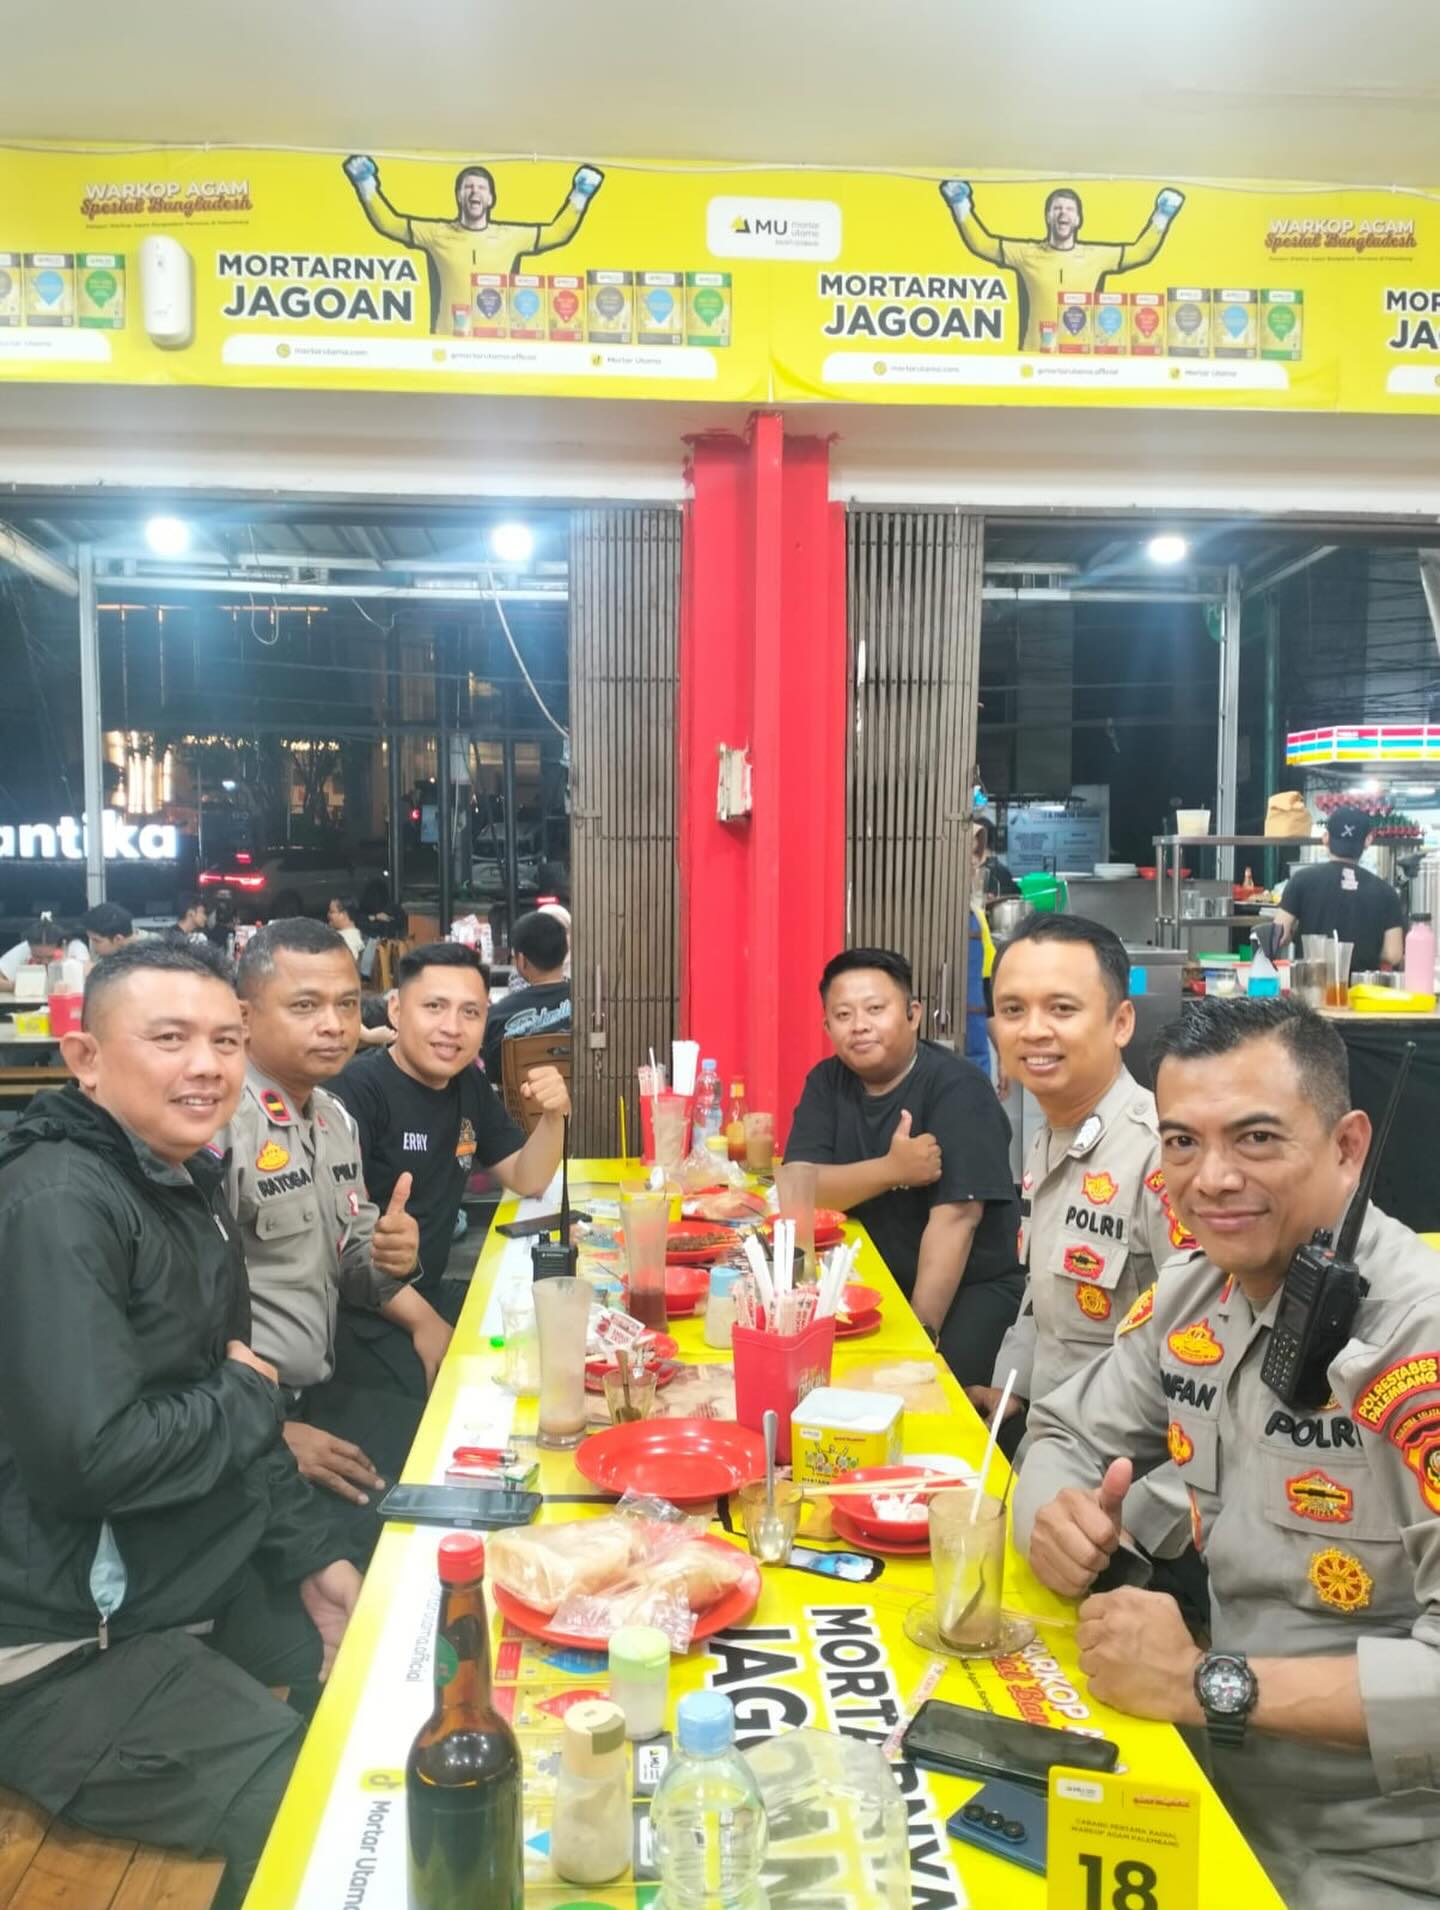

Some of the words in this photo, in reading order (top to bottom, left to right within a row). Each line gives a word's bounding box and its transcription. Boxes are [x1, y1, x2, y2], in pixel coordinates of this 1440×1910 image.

[86, 183, 180, 199] WARKOP
[187, 181, 249, 197] AGAM
[80, 198, 145, 221] Spesial
[148, 195, 253, 218] Bangladesh
[755, 219, 788, 236] MU
[1270, 219, 1353, 233] WARKOP
[1359, 219, 1415, 233] AGAM
[1264, 231, 1322, 254] Spesial
[1324, 231, 1418, 254] Bangladesh
[218, 254, 418, 282] MORTARNYA
[820, 274, 1008, 300] MORTARNYA
[224, 286, 412, 321] JAGOAN
[824, 304, 1002, 339] JAGOAN
[403, 1132, 428, 1152] ERRY
[1065, 1205, 1123, 1240] POLRI
[1358, 1358, 1438, 1418] POLRESTABES
[1368, 1371, 1438, 1424] PALEMBANG
[1023, 1641, 1090, 1720] ARKOP
[359, 1800, 392, 1853] Mortar
[1078, 1853, 1159, 1910] 18
